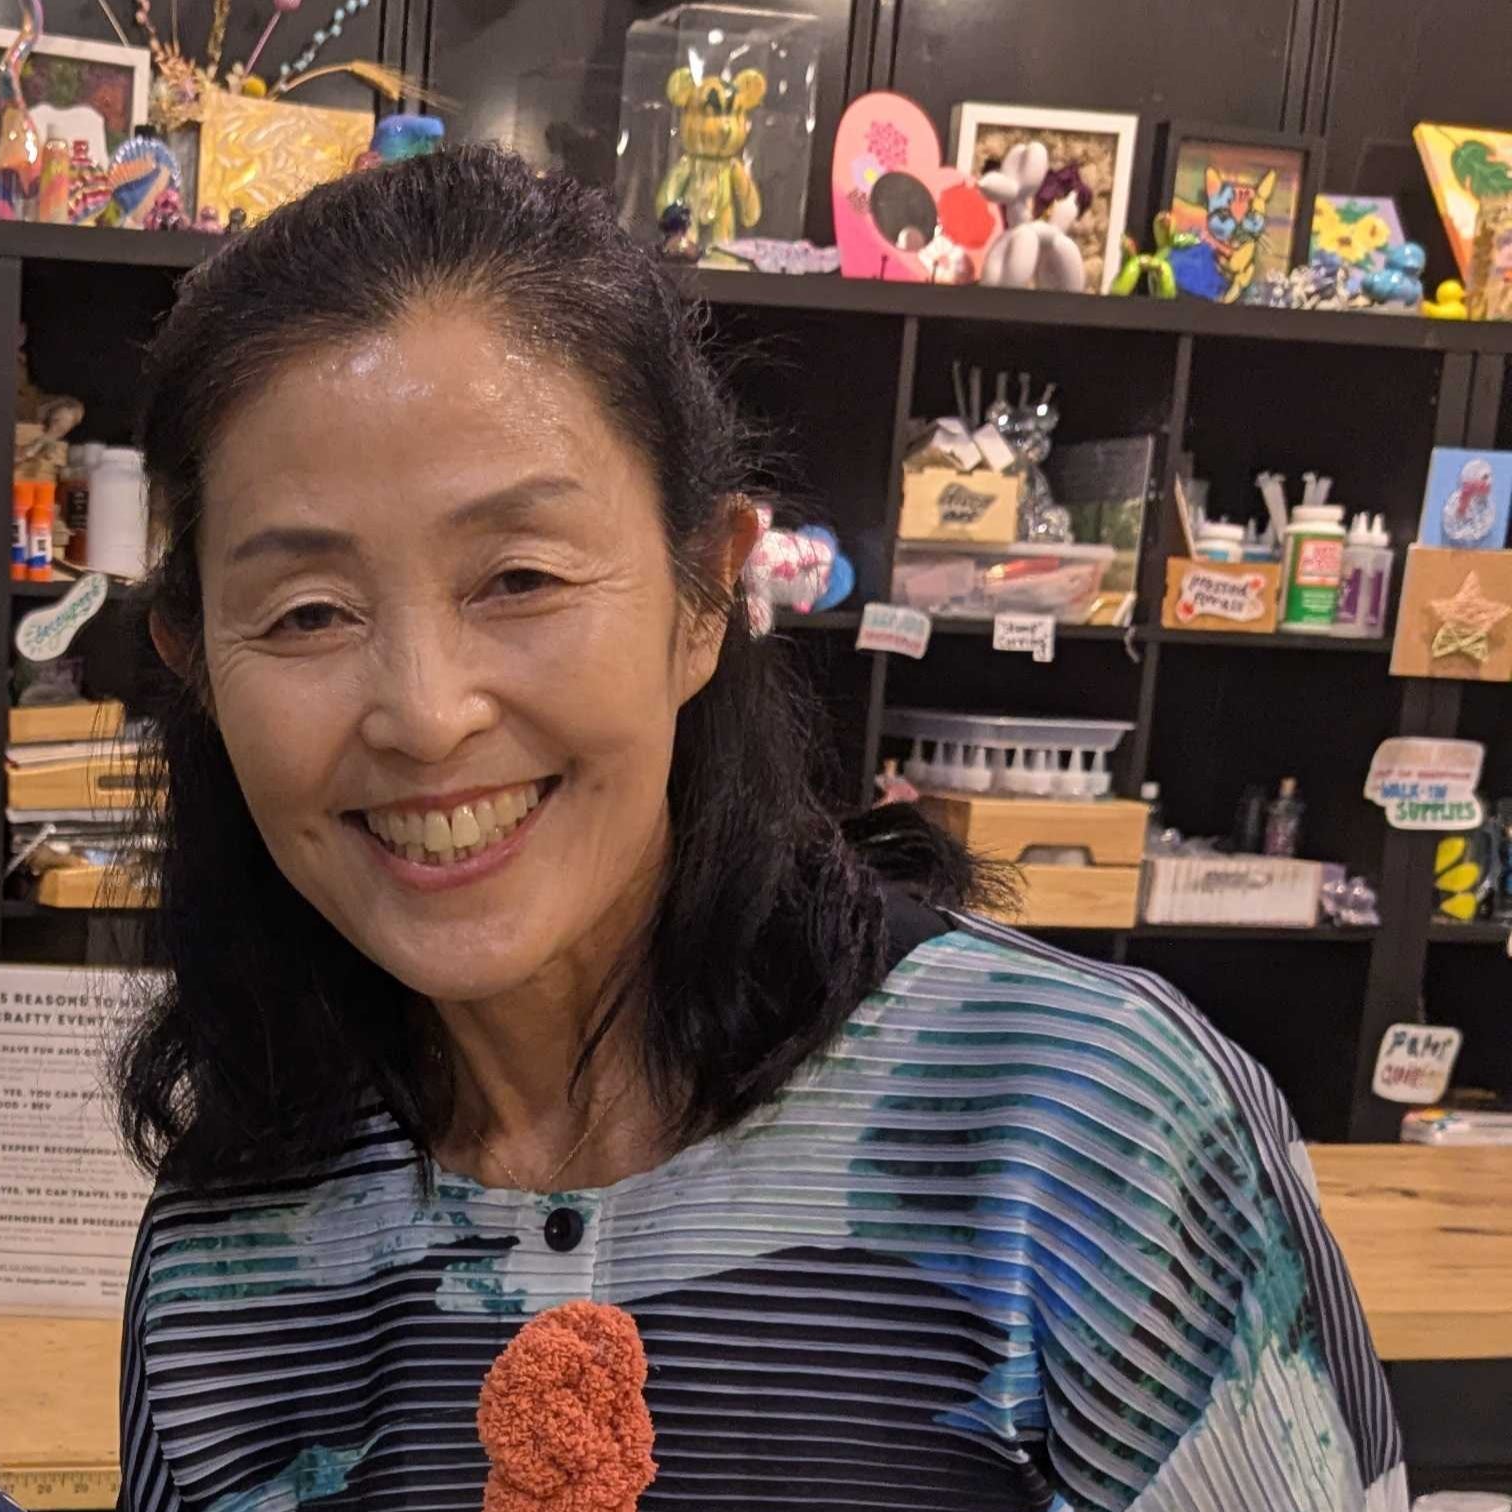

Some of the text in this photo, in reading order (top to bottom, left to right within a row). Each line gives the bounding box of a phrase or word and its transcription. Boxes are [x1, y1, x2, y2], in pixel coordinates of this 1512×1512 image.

[1397, 801, 1477, 821] SUPPLIES
[0, 993, 8, 1004] 5
[14, 993, 88, 1007] REASONS
[58, 1014, 105, 1028] EVENT
[33, 1045, 54, 1055] FUN
[58, 1046, 81, 1056] AND
[30, 1089, 52, 1099] YOU
[55, 1090, 78, 1100] CAN
[1, 1144, 39, 1154] EXPERT
[26, 1188, 41, 1197] WE
[46, 1189, 68, 1198] CAN
[72, 1189, 110, 1199] TRAVEL
[114, 1191, 129, 1200] TO
[0, 1213, 55, 1225] MEMORIES
[59, 1215, 78, 1226] ARE
